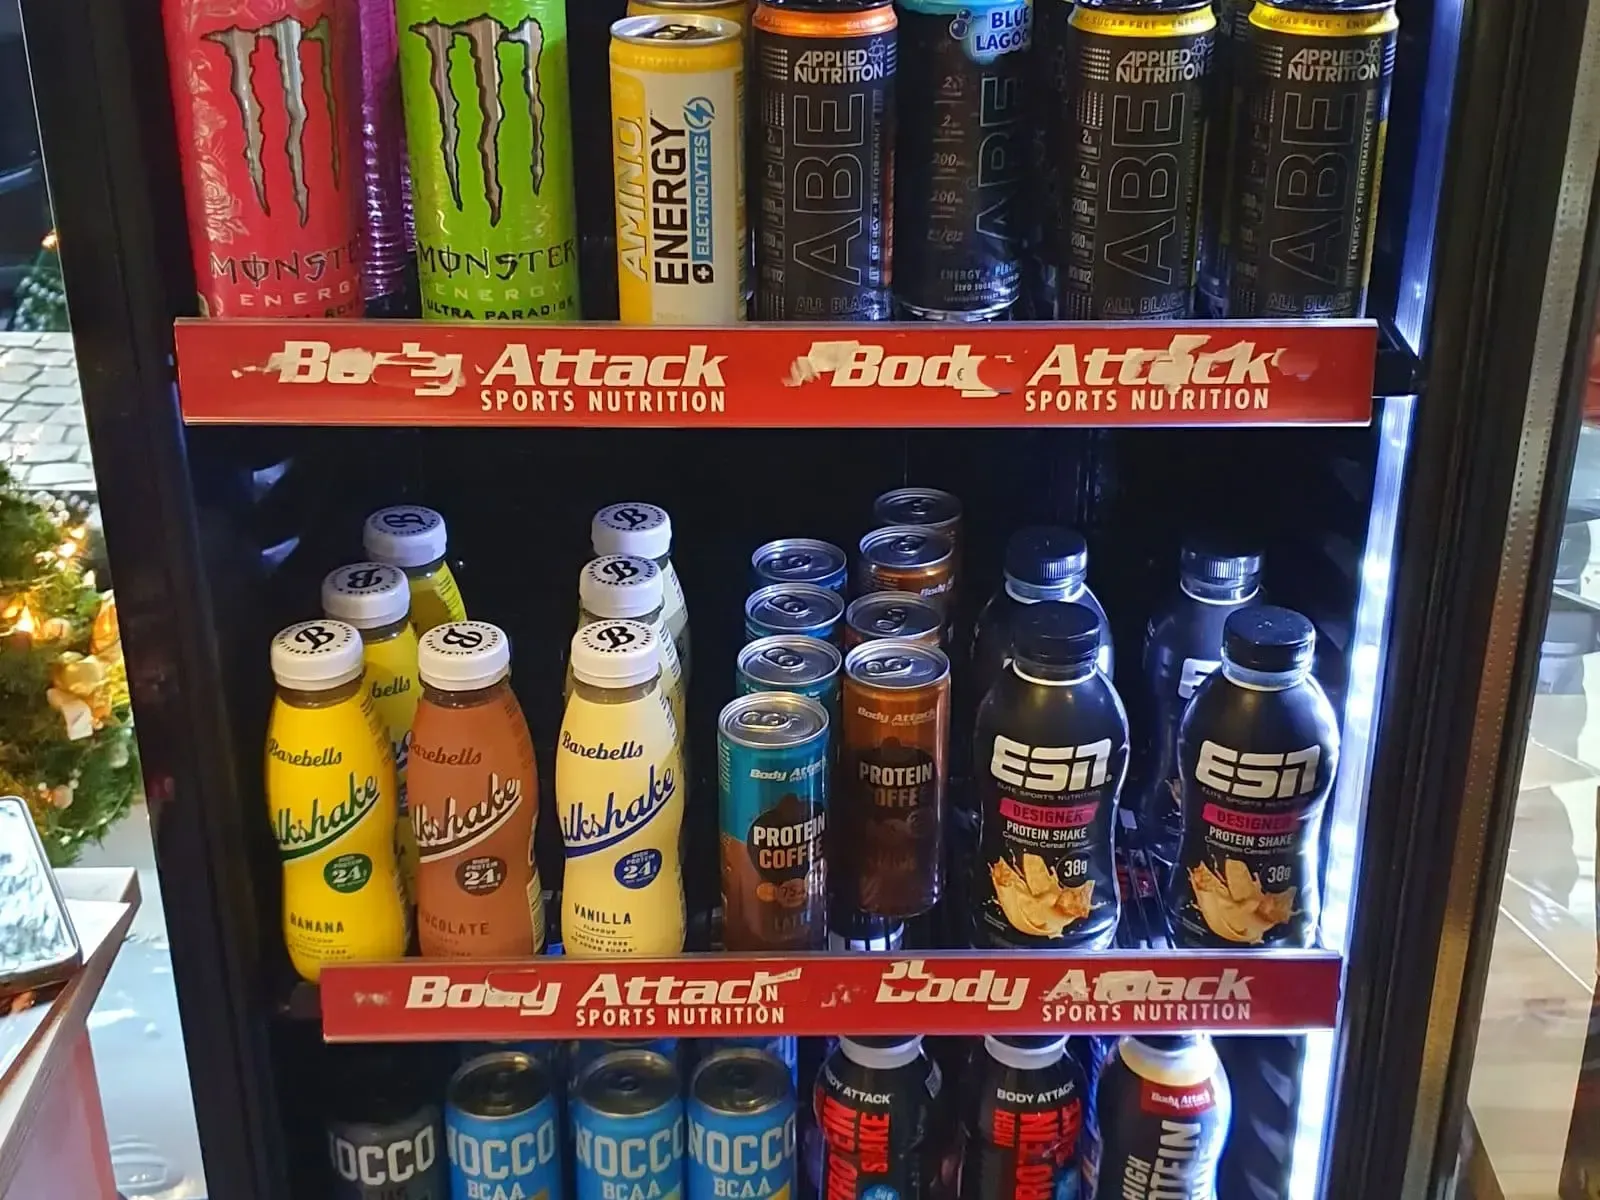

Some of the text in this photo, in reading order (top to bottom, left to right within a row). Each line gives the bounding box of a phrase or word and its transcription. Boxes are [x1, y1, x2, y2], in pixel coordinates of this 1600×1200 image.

[796, 49, 868, 67] APPLIED
[1119, 48, 1191, 67] APPLIED
[1290, 47, 1365, 66] APPLIED
[793, 62, 883, 83] NUTRITION
[1115, 60, 1205, 83] NUTRITION
[1287, 63, 1380, 83] NUTRITION
[619, 116, 648, 283] AMINO
[692, 136, 709, 256] ELECTROLYTES
[793, 93, 865, 286] ABE
[1104, 92, 1185, 285] ABE
[1270, 91, 1358, 286] ABE
[650, 117, 689, 285] ENERGY
[209, 242, 358, 288] MONST
[417, 239, 577, 281] MONSTER
[435, 281, 562, 302] ENERGY
[426, 299, 474, 320] ULTRA
[479, 343, 728, 387] Attack
[480, 389, 726, 413] SPORTS NUTRITION
[1025, 388, 1270, 411] SPORTS NUTRITION
[294, 625, 335, 650] B
[596, 625, 636, 650] B
[371, 675, 411, 699] bells
[562, 730, 644, 761] Barebells
[749, 768, 787, 782] Body
[859, 761, 933, 788] PROTEIN
[874, 787, 918, 808] OFFE
[1013, 804, 1085, 825] DESIGNER
[753, 811, 827, 848] PROTEIN
[1006, 819, 1088, 841] PROTEIN SHAKE
[1208, 825, 1295, 848] PROTEIN SHAKE
[1063, 859, 1088, 879] 38g
[1266, 864, 1292, 884] 38g
[289, 911, 345, 934] BANANA
[574, 902, 632, 925] VANILLA
[575, 1007, 785, 1027] SPORTS NUTRITION
[1042, 1002, 1251, 1022] SPORTS NUTRITION
[842, 1086, 892, 1105] ATTACK
[996, 1079, 1075, 1104] BODY ATTACK
[328, 1124, 436, 1187] OCCO
[575, 1116, 684, 1180] NOCCO
[688, 1112, 796, 1176] NOCCO
[712, 1174, 772, 1199] BCAA
[1122, 1154, 1152, 1200] HIGH
[467, 1181, 526, 1200] BCAA
[602, 1180, 662, 1200] BCAA
